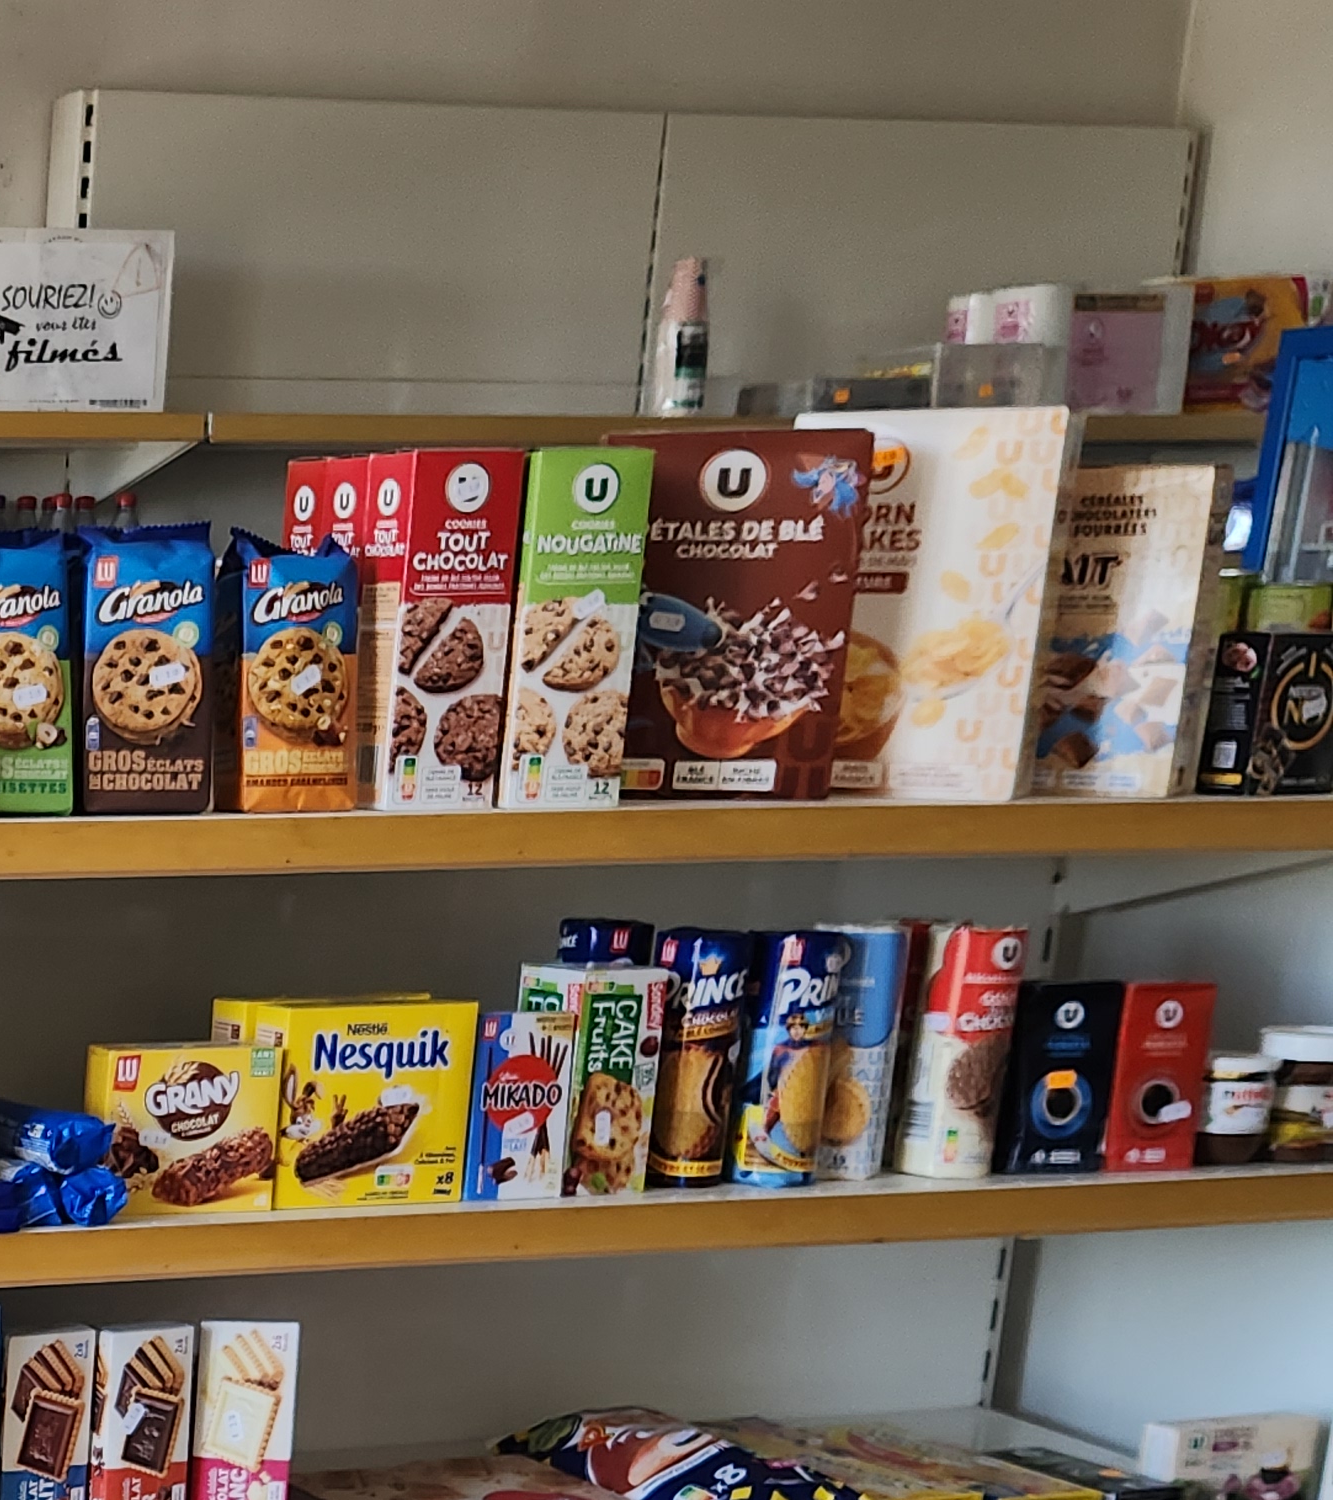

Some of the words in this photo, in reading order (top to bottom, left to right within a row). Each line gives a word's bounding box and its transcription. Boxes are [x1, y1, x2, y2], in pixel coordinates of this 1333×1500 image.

[1, 283, 96, 311] SOURIEZ!
[36, 320, 67, 332] vous
[5, 337, 123, 372] filmés
[374, 529, 398, 544] TOUT
[437, 530, 491, 551] TOUT
[741, 521, 776, 543] DE
[776, 516, 826, 543] BLÉ
[536, 532, 643, 556] NOUGATINE
[676, 541, 778, 560] CHOCOLAT
[95, 560, 115, 583] LU
[412, 552, 508, 571] CHOCOLAT
[251, 562, 268, 584] LU
[98, 579, 203, 624] Granola
[253, 582, 344, 625] Granola
[88, 750, 145, 772] GROS
[147, 758, 205, 772] ÉCLATS
[246, 751, 302, 774] GROS
[102, 772, 203, 791] CHOCOLAT
[466, 783, 483, 796] 12
[594, 782, 610, 795] 12
[614, 931, 629, 948] LU
[661, 941, 677, 962] LU
[668, 970, 748, 1012] PRINCE
[484, 1020, 498, 1039] LU
[587, 1001, 617, 1073] Fruits
[608, 1000, 639, 1070] CAKE
[313, 1029, 451, 1080] Nesquik
[117, 1060, 138, 1079] LU
[144, 1071, 240, 1117] GRANY
[481, 1083, 563, 1110] MIKADO
[170, 1113, 221, 1134] CHOCOLAT
[436, 1171, 454, 1185] x8
